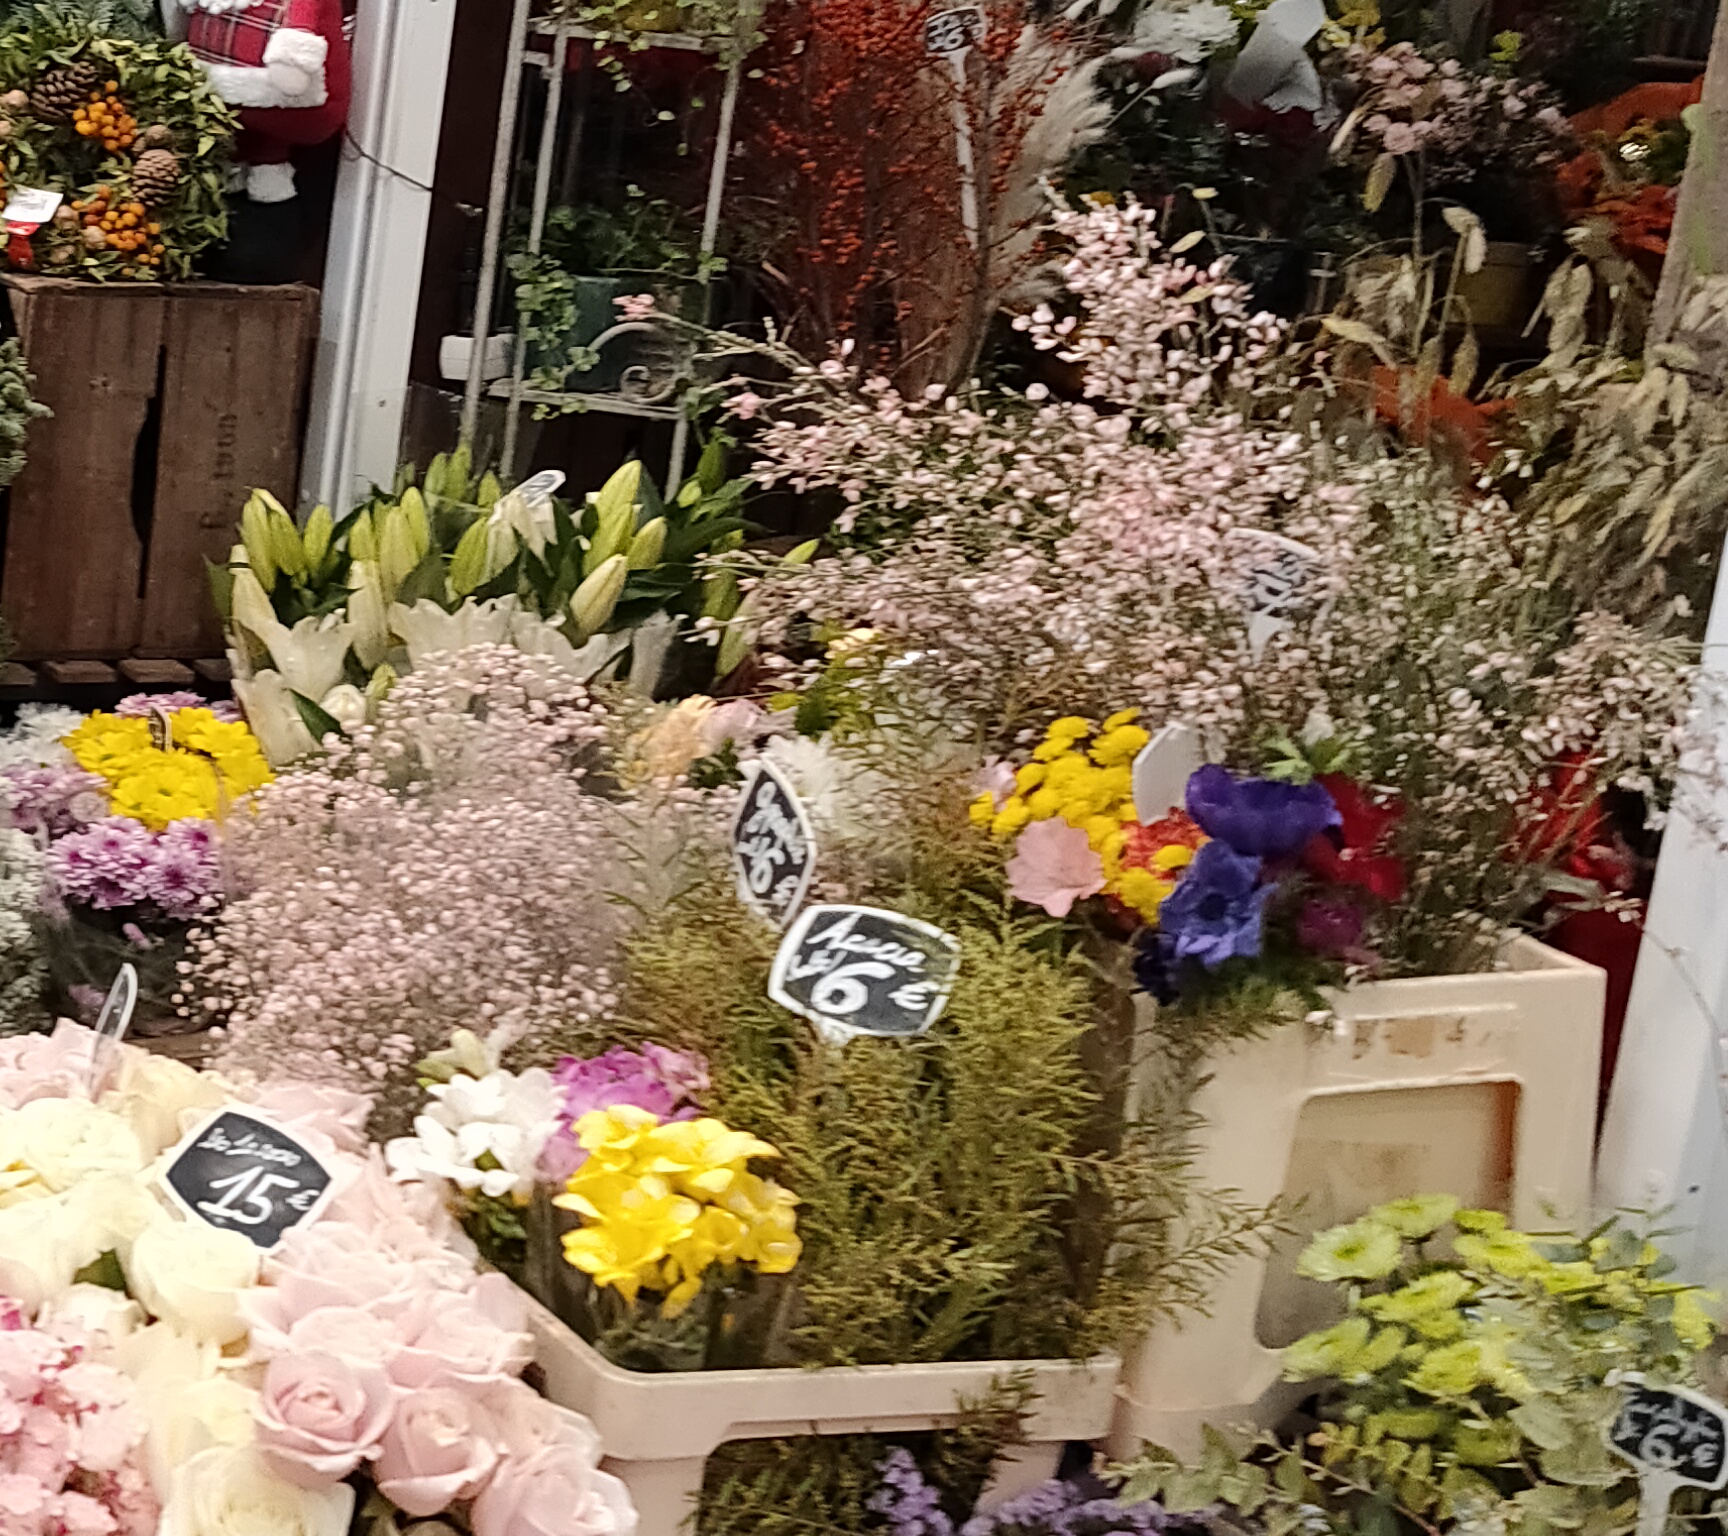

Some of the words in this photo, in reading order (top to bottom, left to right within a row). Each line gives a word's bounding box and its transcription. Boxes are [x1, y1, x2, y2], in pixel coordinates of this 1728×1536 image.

[811, 962, 896, 1014] 6
[887, 980, 942, 1010] €
[197, 1166, 300, 1225] 15
[285, 1189, 321, 1211] €
[1640, 1424, 1681, 1466] 6
